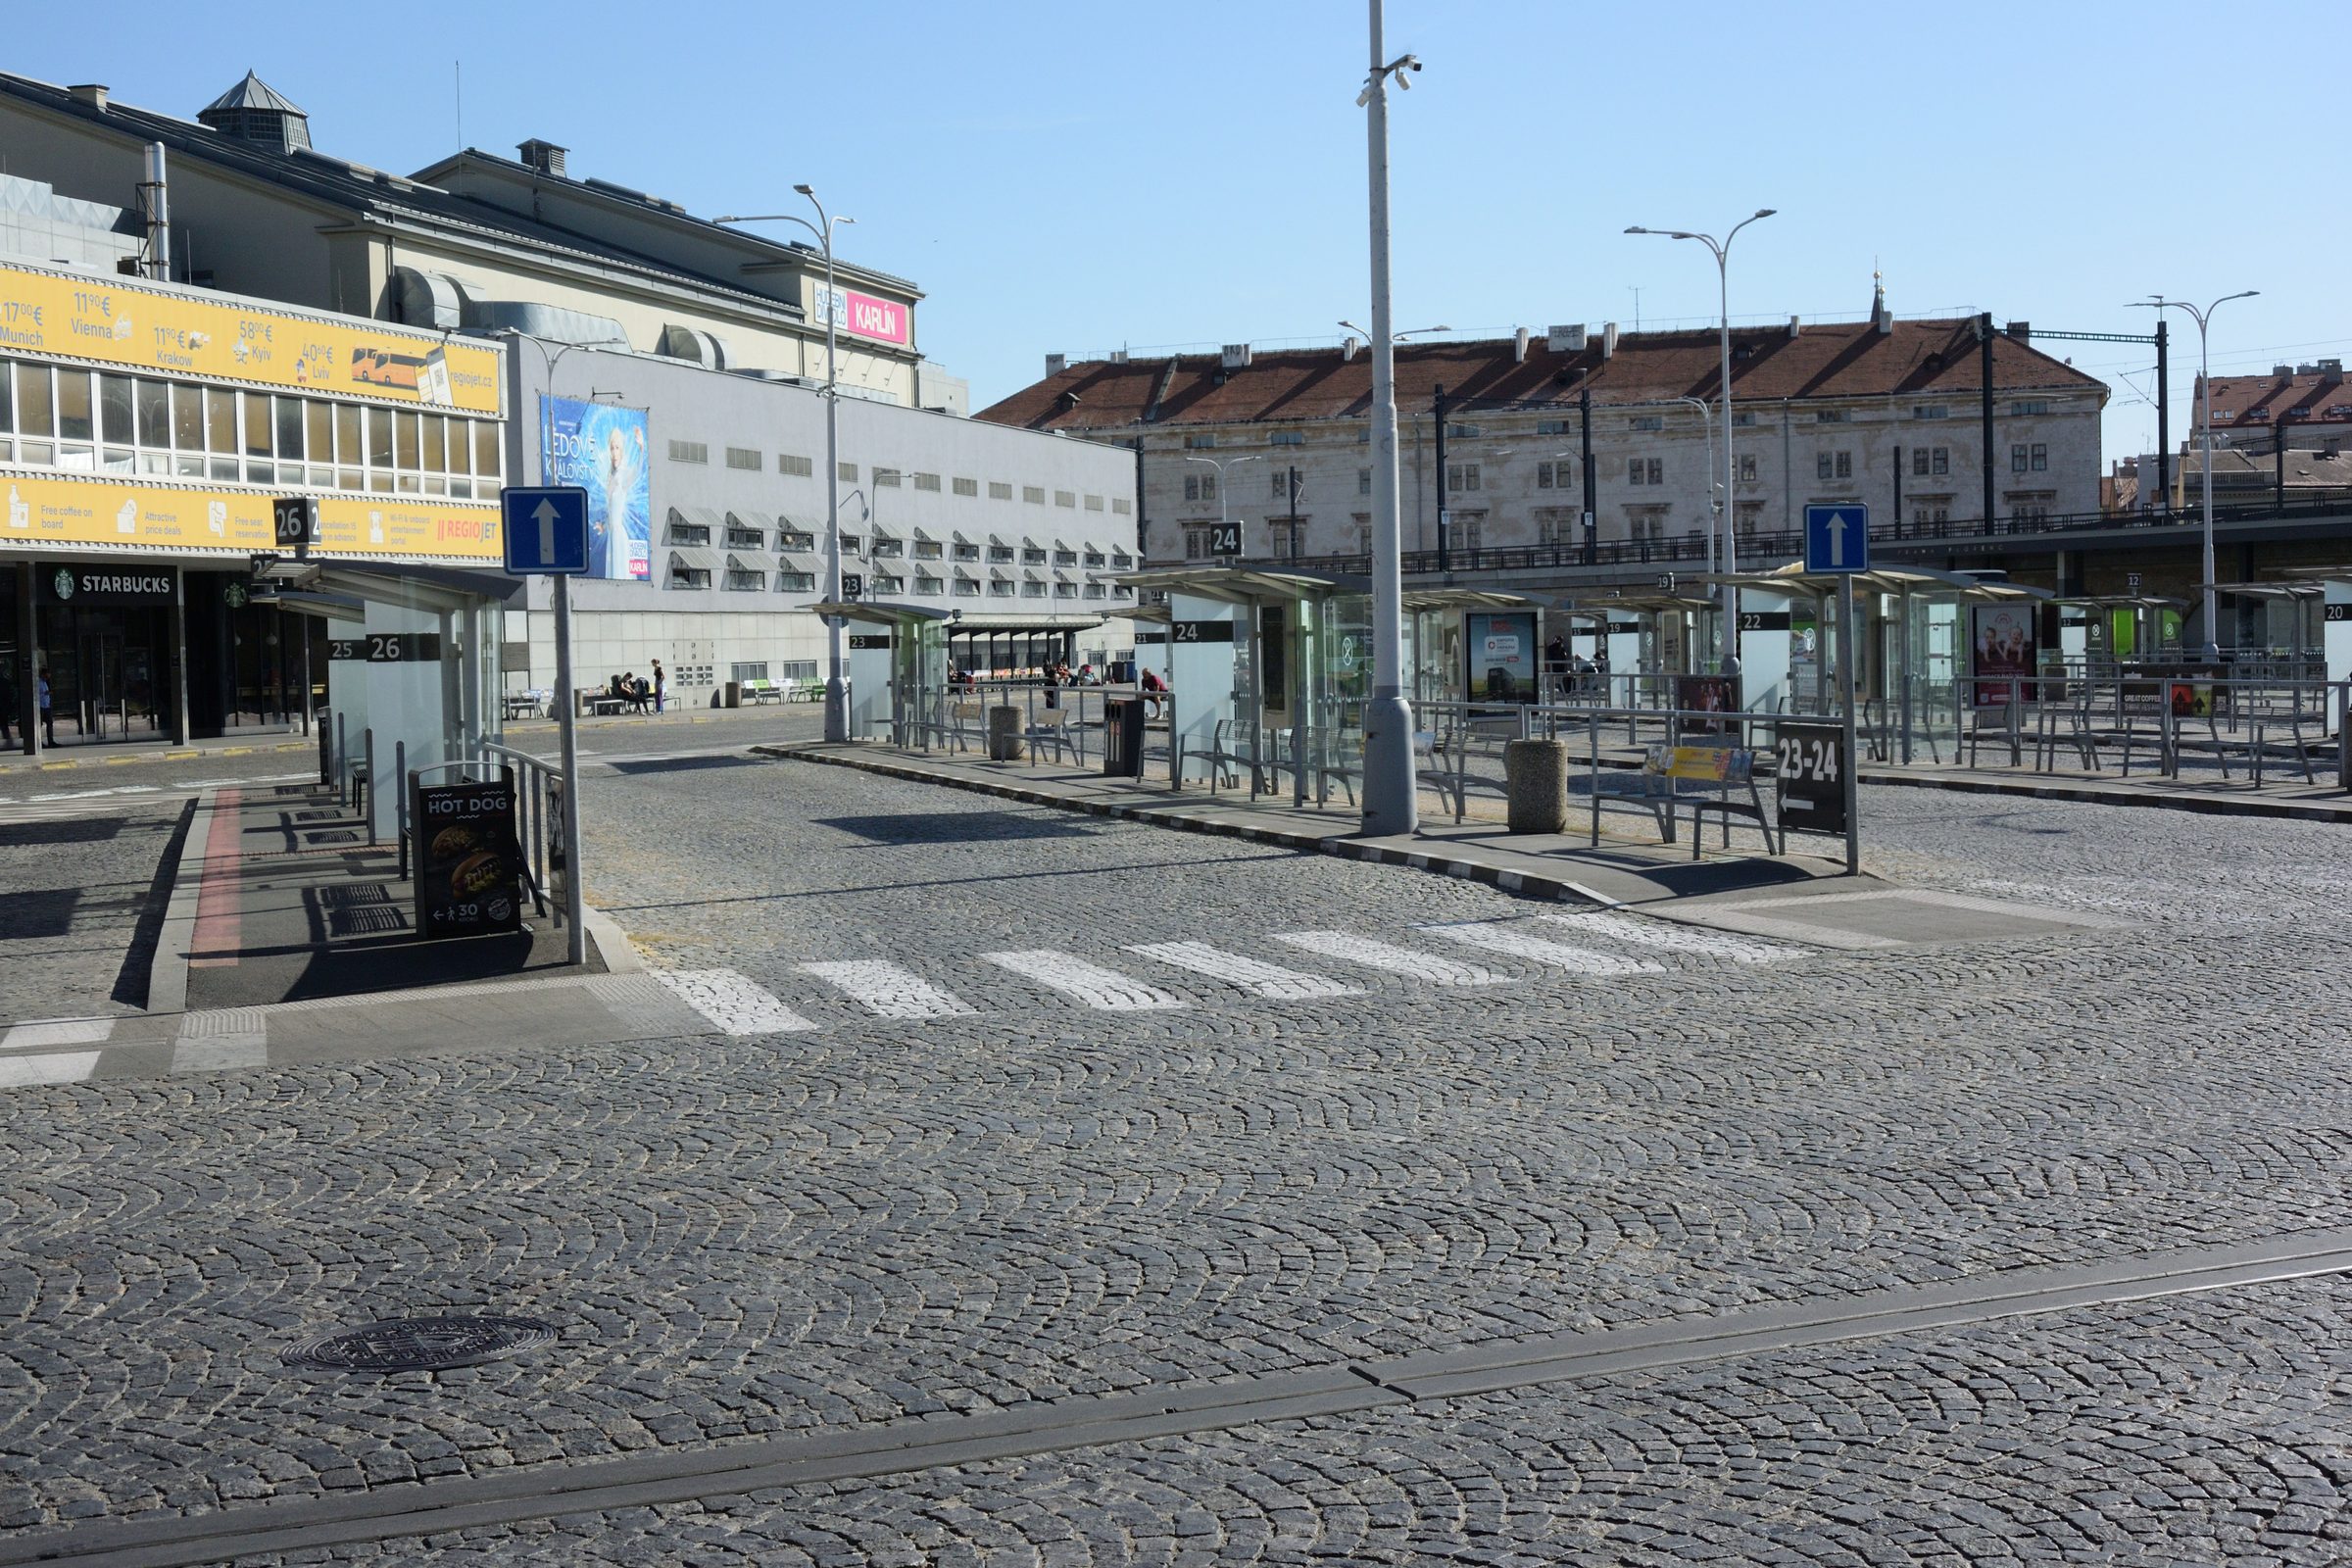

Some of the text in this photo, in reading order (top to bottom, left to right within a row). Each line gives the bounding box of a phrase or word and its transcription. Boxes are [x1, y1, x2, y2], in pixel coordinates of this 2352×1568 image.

[856, 303, 896, 336] KARLÍN
[0, 326, 43, 346] Munich
[71, 318, 113, 339] Vienna
[157, 349, 193, 367] Krakow
[252, 346, 271, 363] Kyiv
[313, 366, 330, 379] Lviv
[450, 370, 492, 388] regiojet.cz
[41, 505, 58, 515] Free
[59, 507, 81, 517] coffee
[145, 512, 177, 522] Attractive
[41, 518, 64, 529] board
[235, 516, 248, 526] Free
[275, 507, 302, 537] 26
[145, 525, 181, 536] price deals
[448, 520, 497, 543] REGIOJET
[1213, 527, 1237, 550] 24
[82, 574, 170, 594] STARBUCKS
[845, 578, 858, 593] 23
[1658, 576, 1669, 588] 19
[2129, 576, 2140, 586] 12
[2328, 606, 2344, 619] 20
[1609, 623, 1621, 633] 19
[1744, 614, 1762, 629] 22
[1136, 634, 1148, 644] 21
[1177, 623, 1199, 641] 24
[371, 637, 401, 660] 26
[852, 636, 865, 648] 23
[332, 642, 353, 658] 25
[1779, 738, 1838, 783] 23-24
[428, 797, 508, 814] HOT DOG
[458, 904, 478, 916] 30
